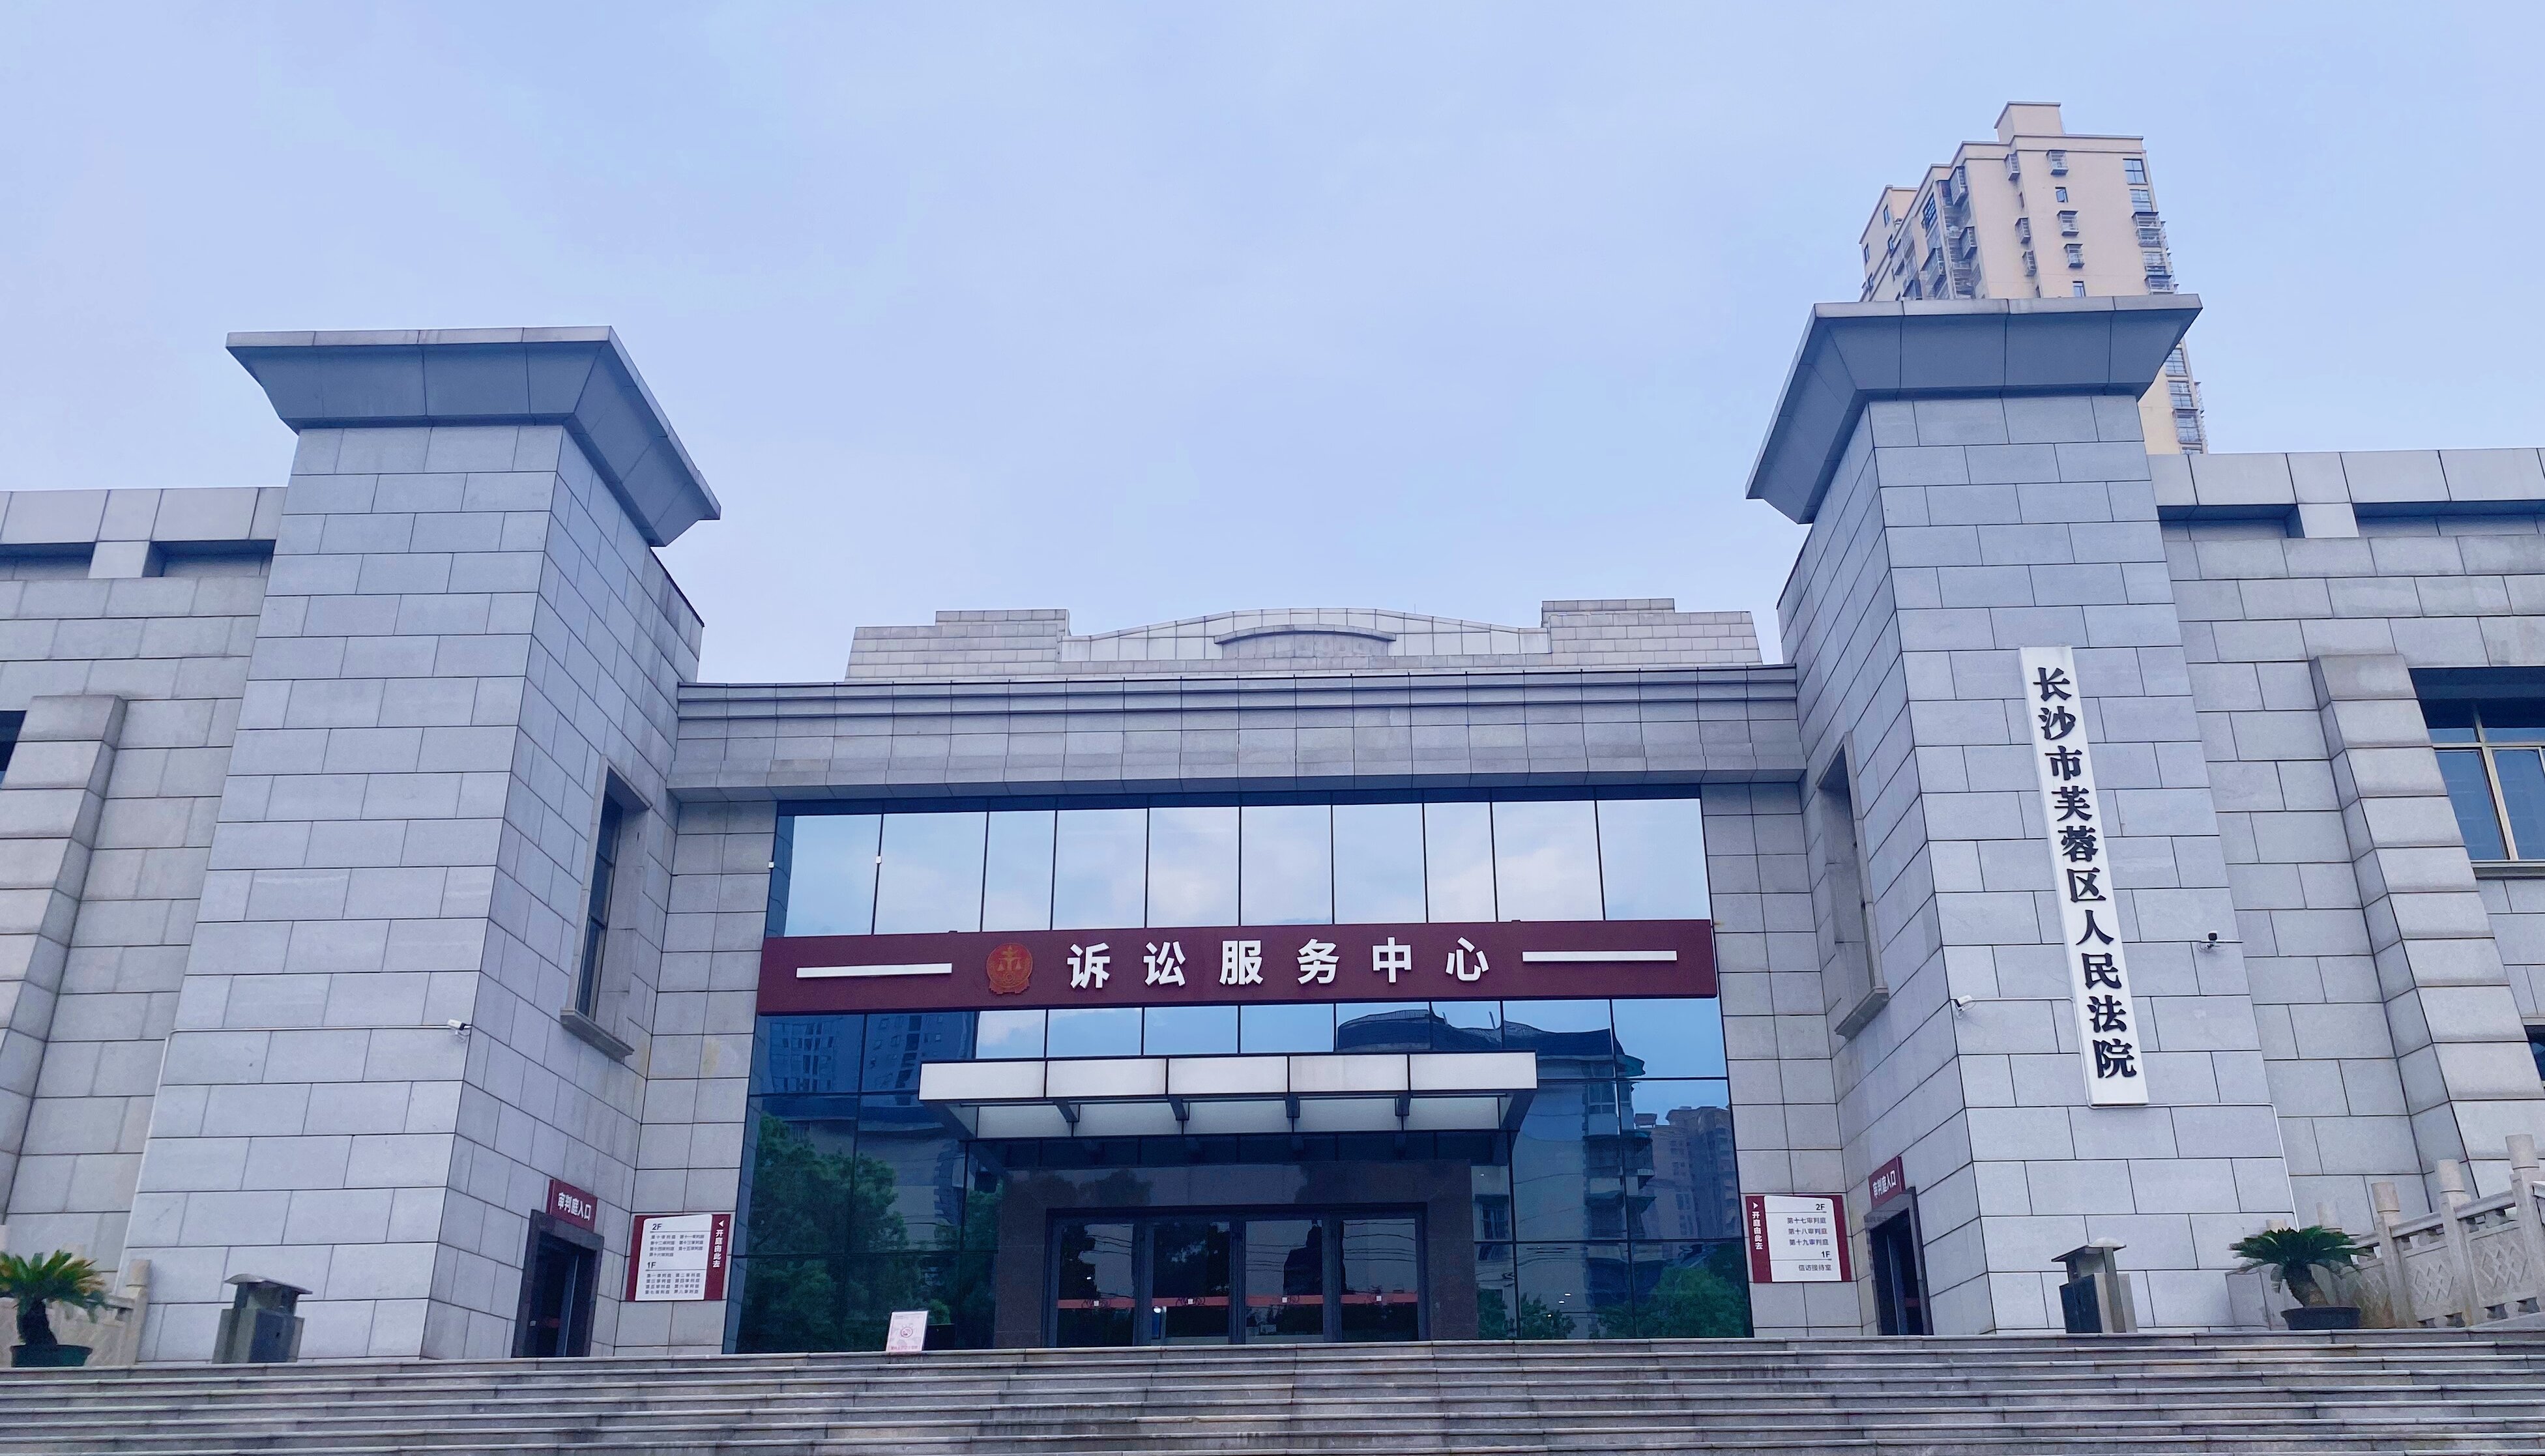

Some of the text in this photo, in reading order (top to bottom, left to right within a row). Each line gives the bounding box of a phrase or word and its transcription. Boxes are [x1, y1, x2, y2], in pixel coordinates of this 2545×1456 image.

[2033, 665, 2137, 1079] 长沙市芙蓉区人民法院
[1068, 937, 1489, 989] 诉讼服务中心
[557, 1192, 592, 1221] 审判庭入口
